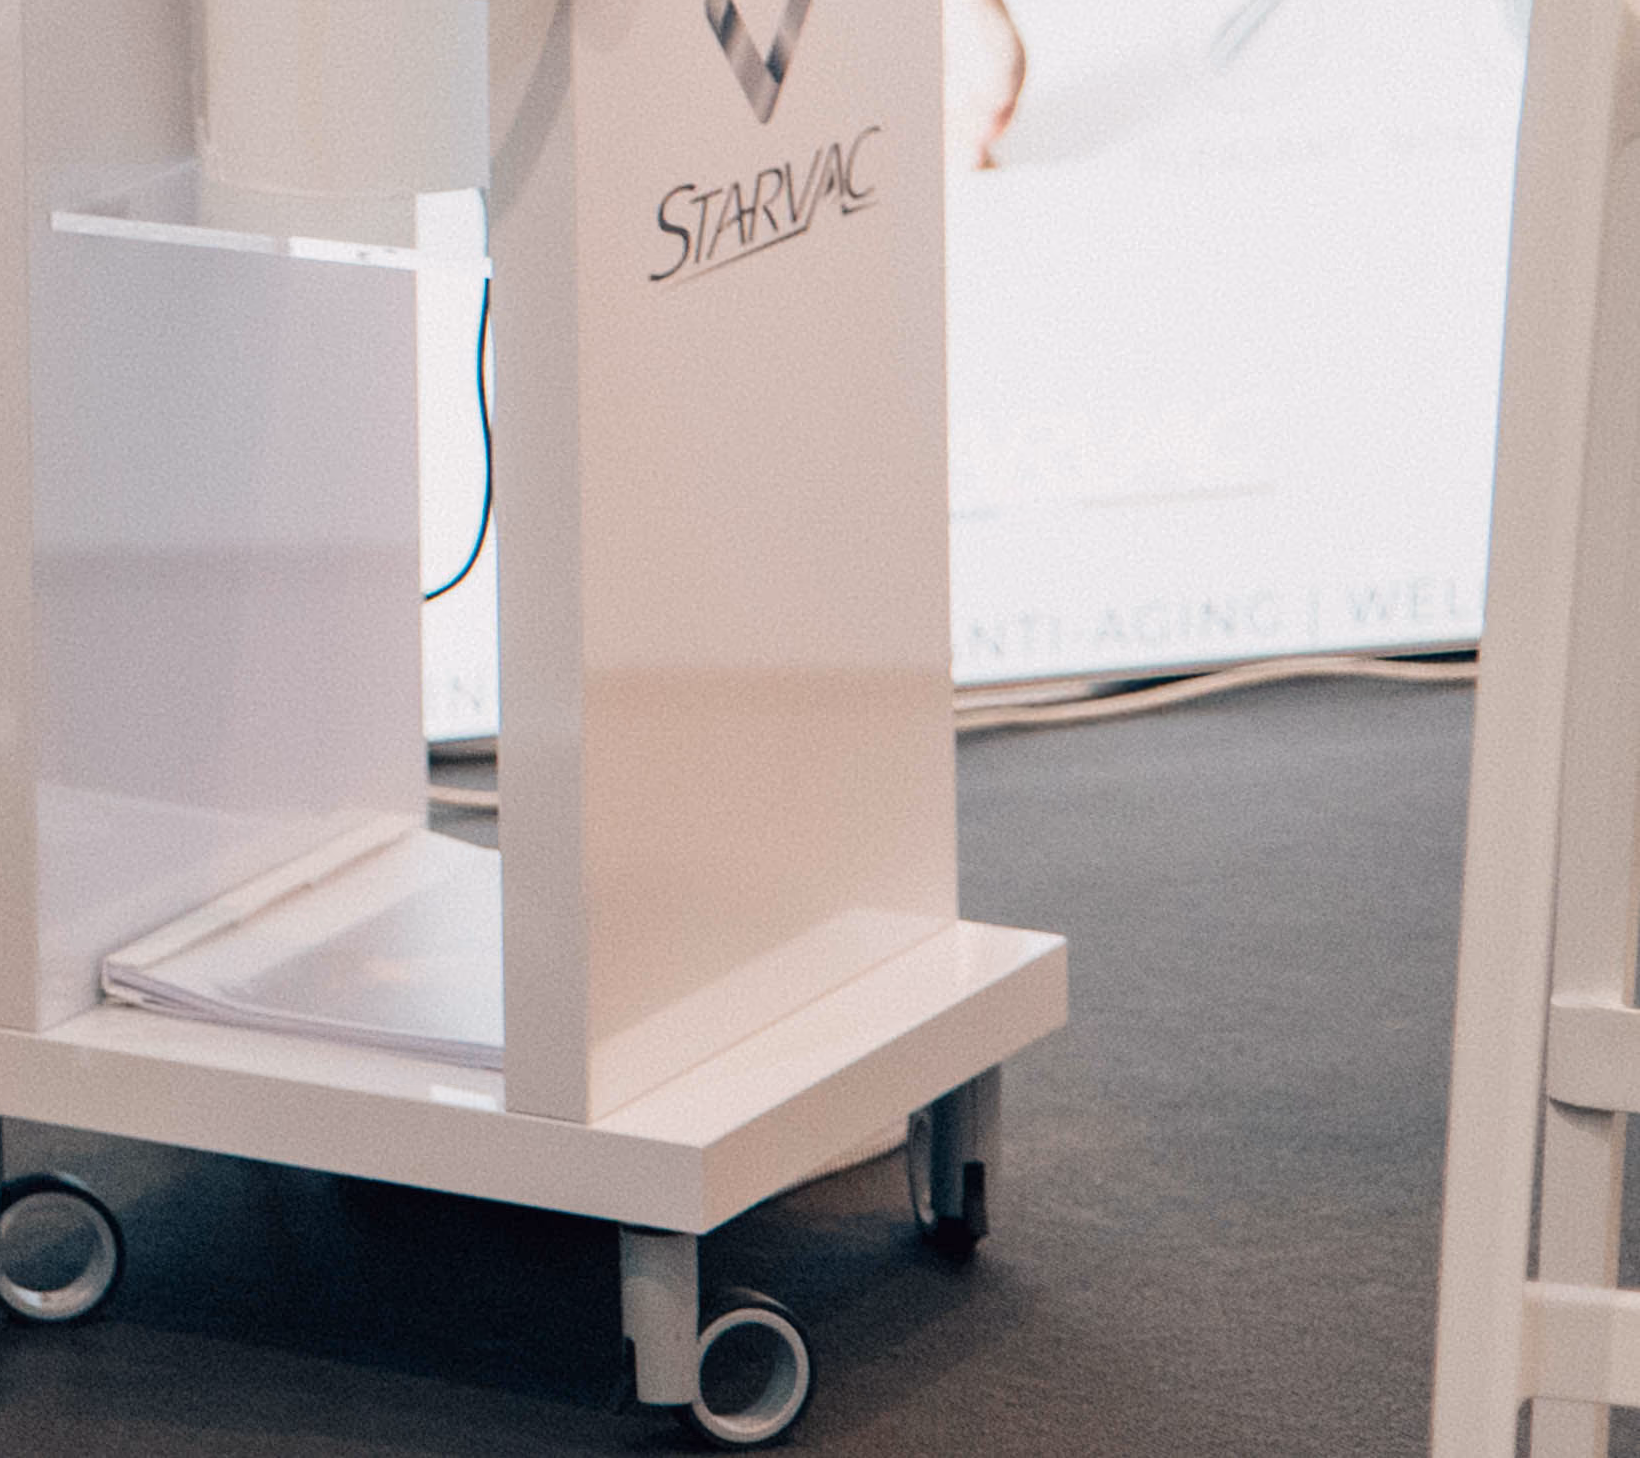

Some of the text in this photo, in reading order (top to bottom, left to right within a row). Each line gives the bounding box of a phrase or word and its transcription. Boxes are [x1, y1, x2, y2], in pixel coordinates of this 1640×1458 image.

[648, 125, 881, 282] STARVAC
[968, 573, 1477, 660] NTI-AGING WEL
